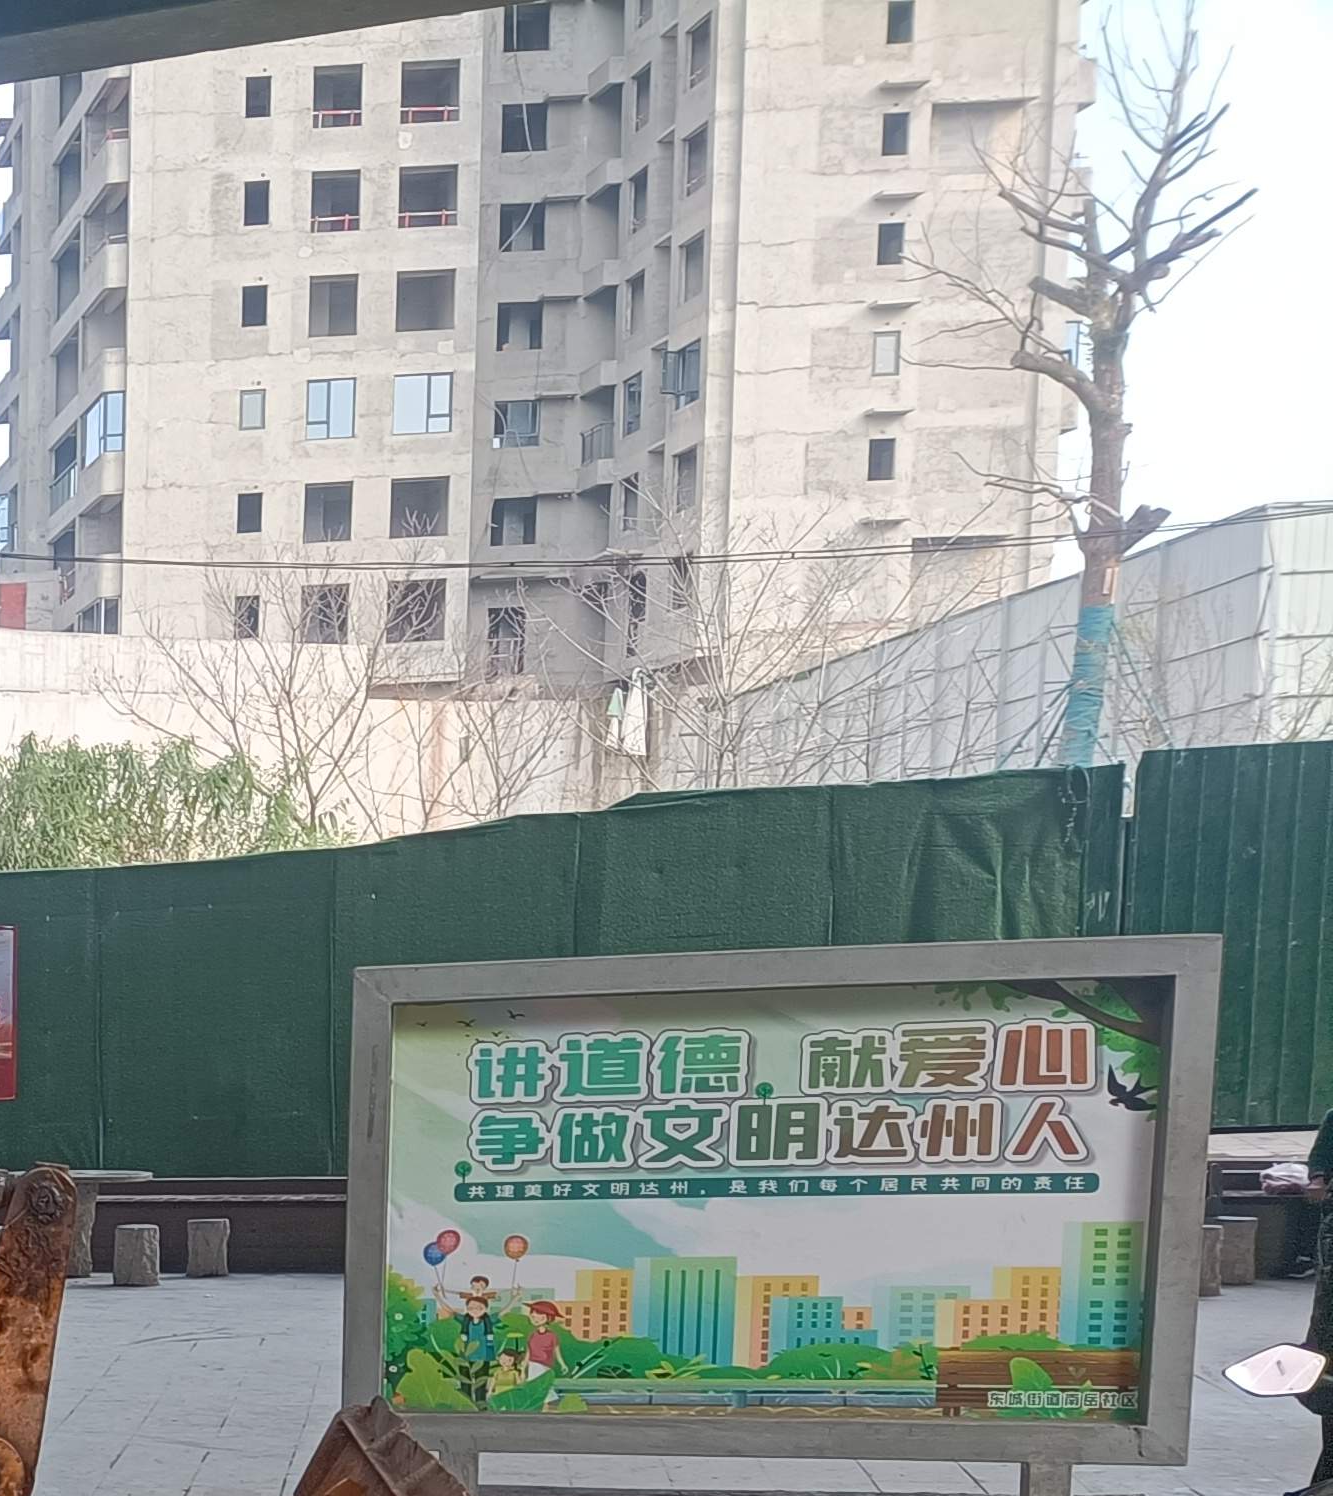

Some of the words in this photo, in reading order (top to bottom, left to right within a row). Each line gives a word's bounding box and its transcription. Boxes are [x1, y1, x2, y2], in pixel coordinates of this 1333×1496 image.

[474, 1033, 743, 1099] 讲道德
[807, 1024, 1088, 1089] 献爱心
[475, 1101, 1081, 1166] 争做文明达州人
[987, 1391, 1138, 1408] 东城街道南岳社区
